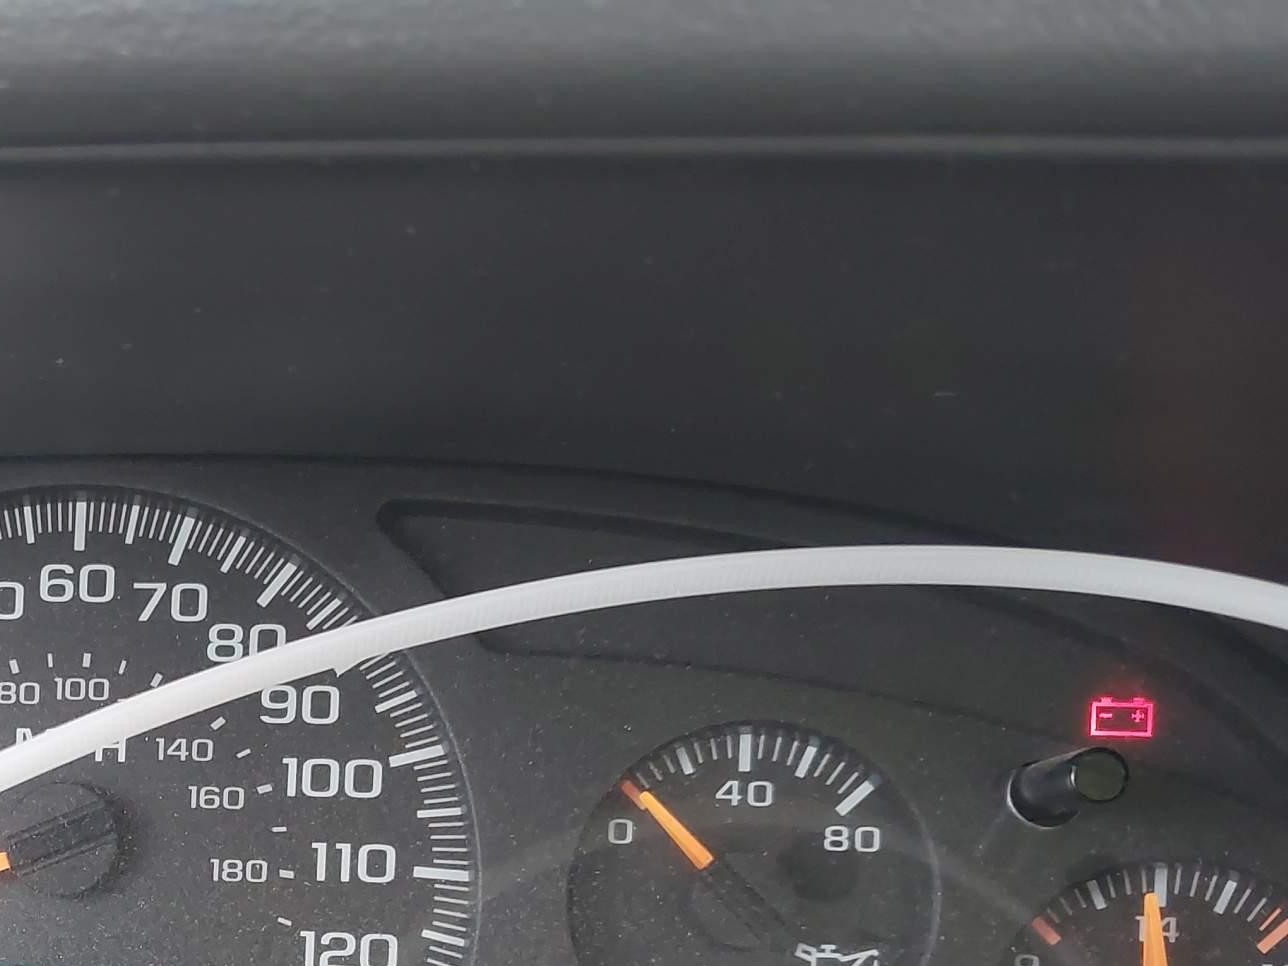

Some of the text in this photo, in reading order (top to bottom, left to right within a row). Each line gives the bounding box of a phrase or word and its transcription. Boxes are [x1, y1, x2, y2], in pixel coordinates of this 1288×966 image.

[40, 564, 115, 603] 60
[133, 583, 208, 622] 70
[207, 624, 287, 662] 80
[54, 677, 110, 701] 100
[260, 685, 340, 725] 90
[156, 738, 213, 762] 140
[282, 758, 383, 799] 100
[188, 785, 245, 810] 160
[715, 780, 774, 807] 40
[608, 818, 633, 845] 0
[824, 825, 880, 852] 80
[210, 858, 268, 883] 180
[312, 842, 396, 884] 110
